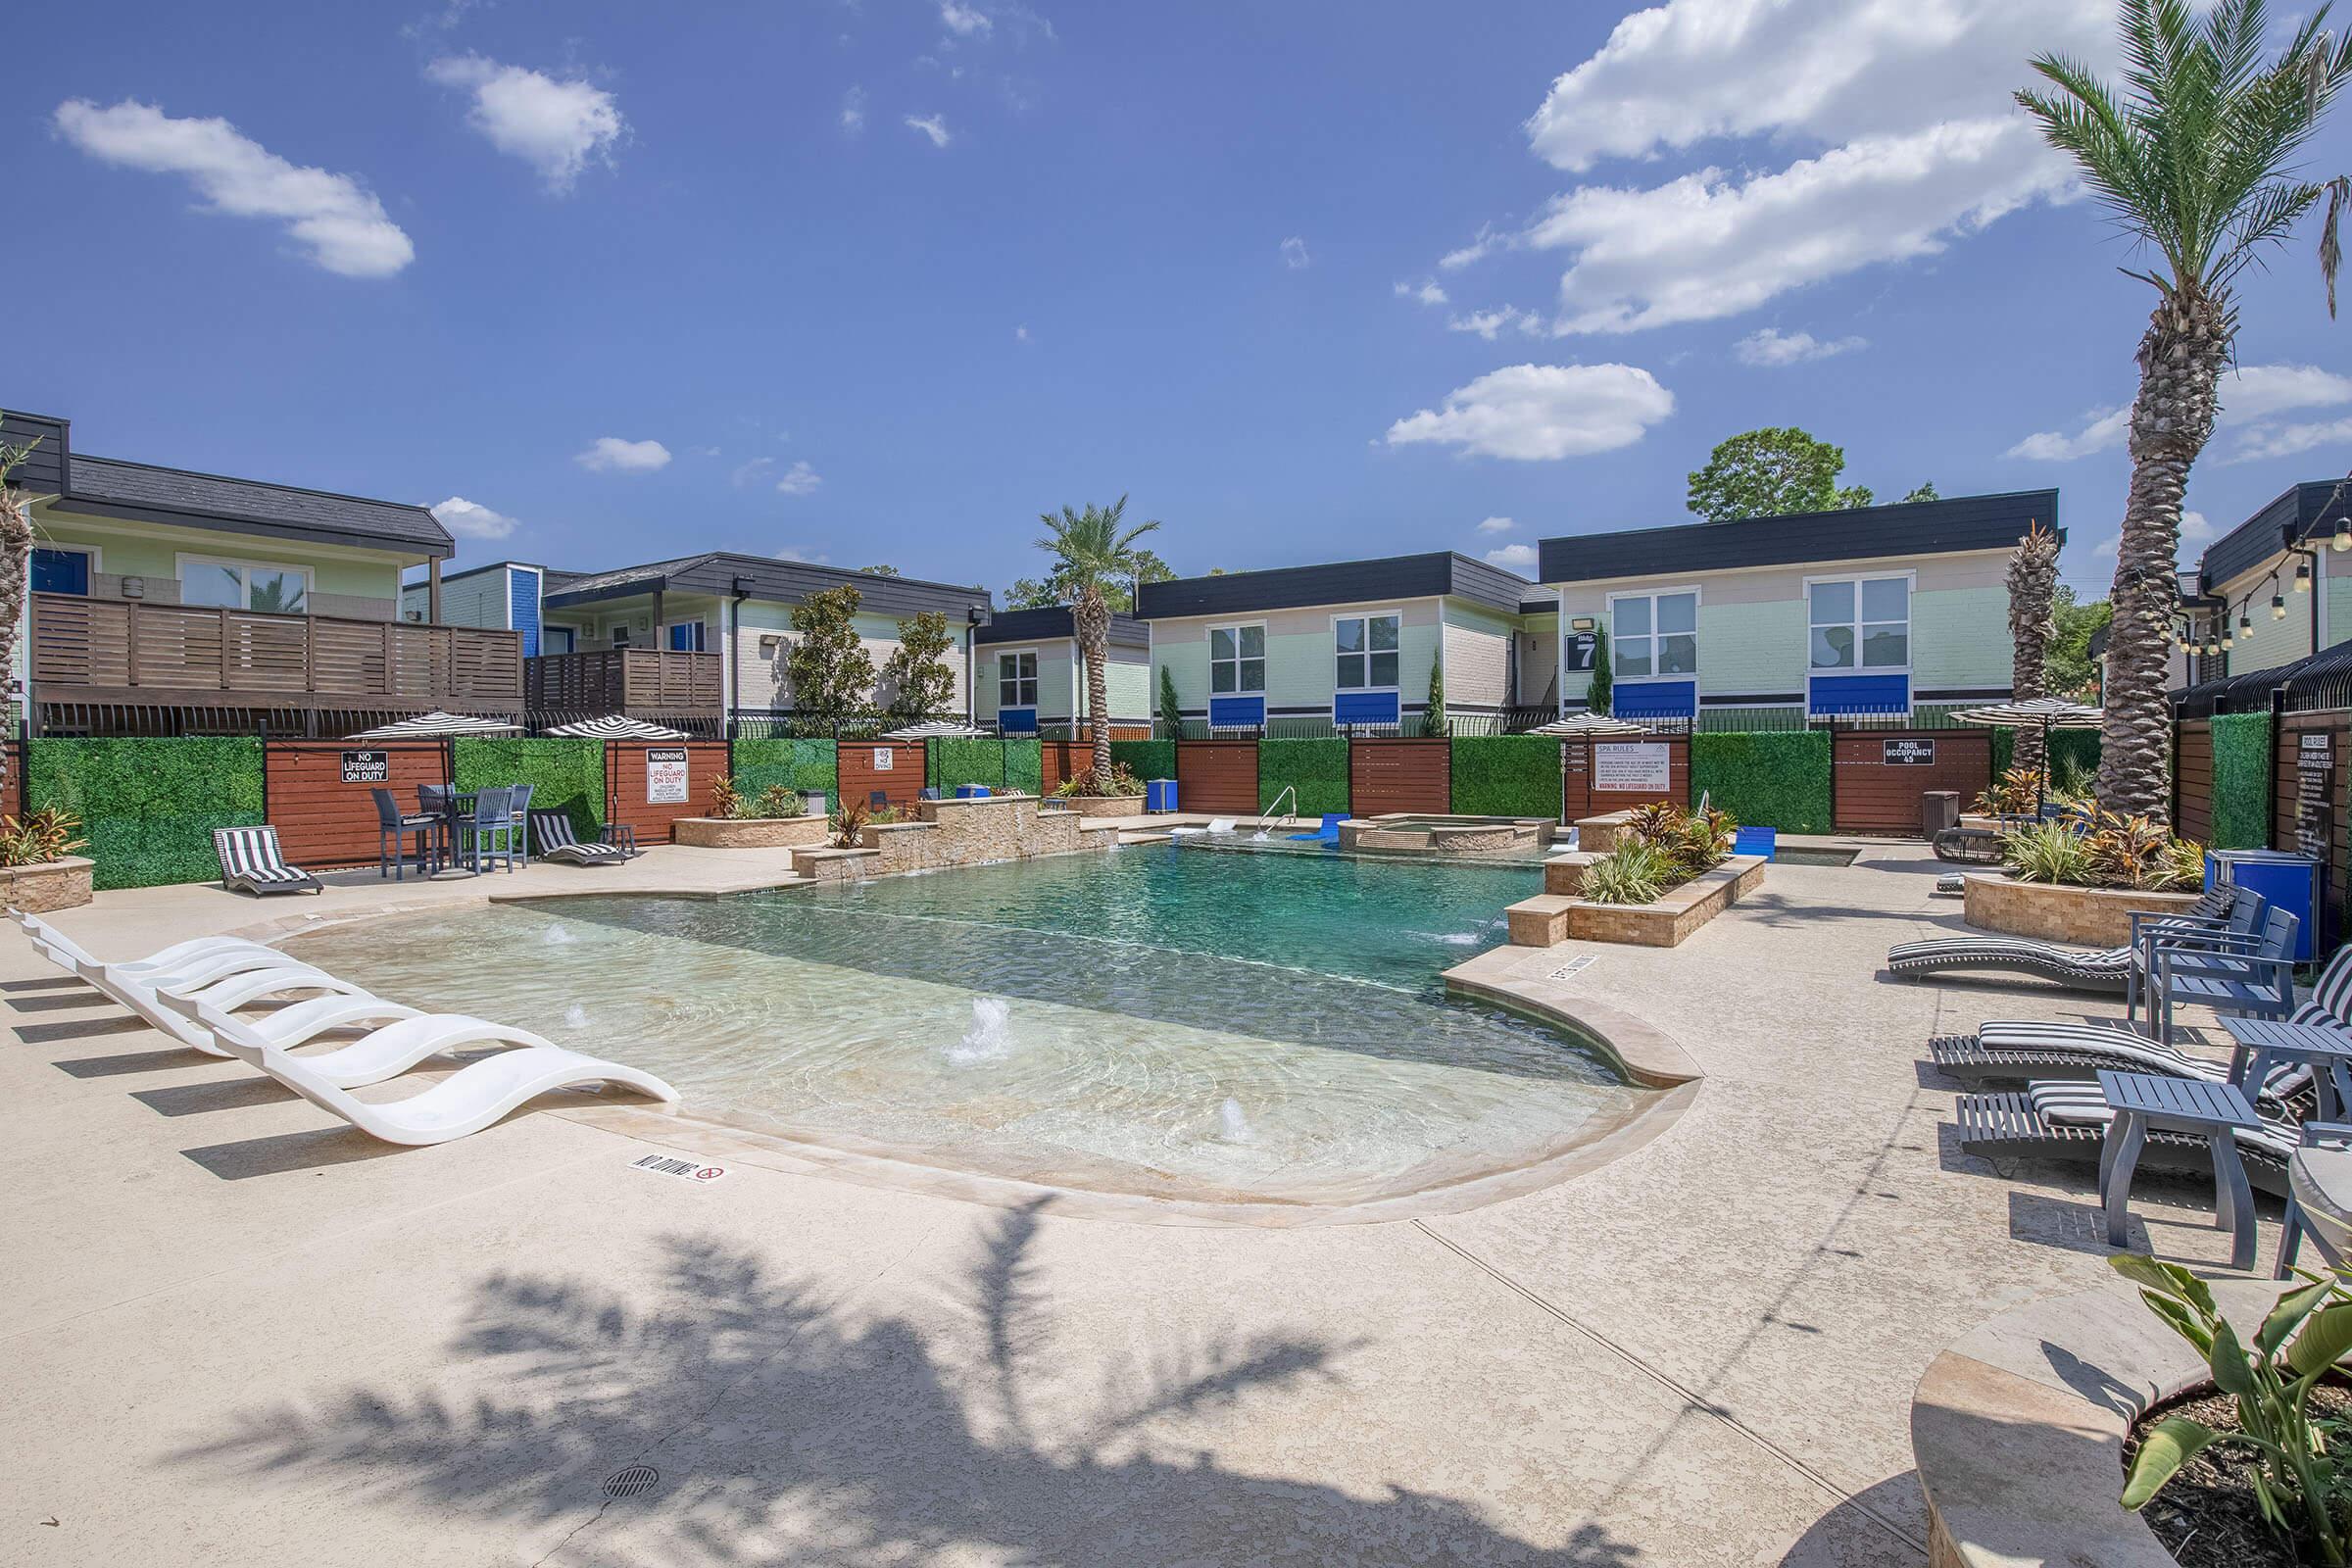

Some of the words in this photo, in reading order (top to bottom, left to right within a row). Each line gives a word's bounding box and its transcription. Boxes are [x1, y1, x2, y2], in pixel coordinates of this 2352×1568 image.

[1577, 643, 1595, 667] 7
[358, 753, 371, 761] NO
[651, 752, 684, 760] WARNING
[344, 761, 385, 771] LIFEGUARD
[346, 771, 360, 780] ON
[362, 771, 384, 780] DUTY
[632, 1154, 662, 1166] NO
[650, 1158, 700, 1176] DIVING
